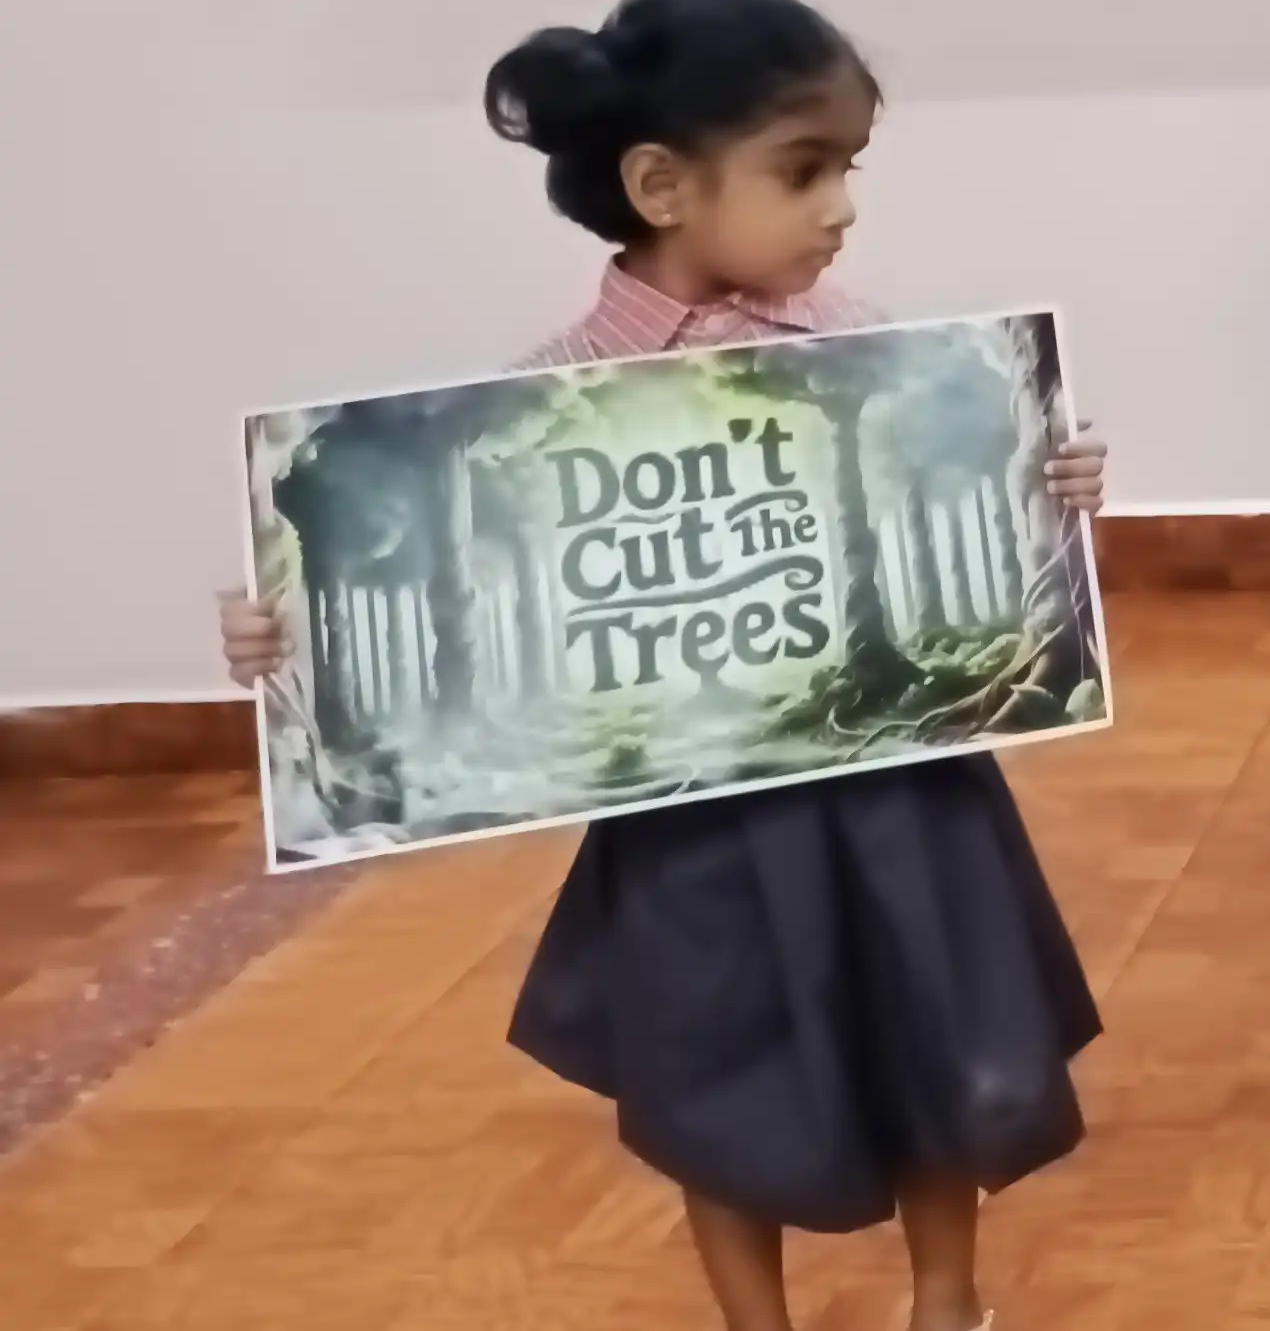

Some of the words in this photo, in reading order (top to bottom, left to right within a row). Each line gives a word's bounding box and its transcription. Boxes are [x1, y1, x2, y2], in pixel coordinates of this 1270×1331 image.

[544, 415, 796, 529] Don't
[561, 507, 722, 600] Cut
[565, 590, 830, 694] Trees
